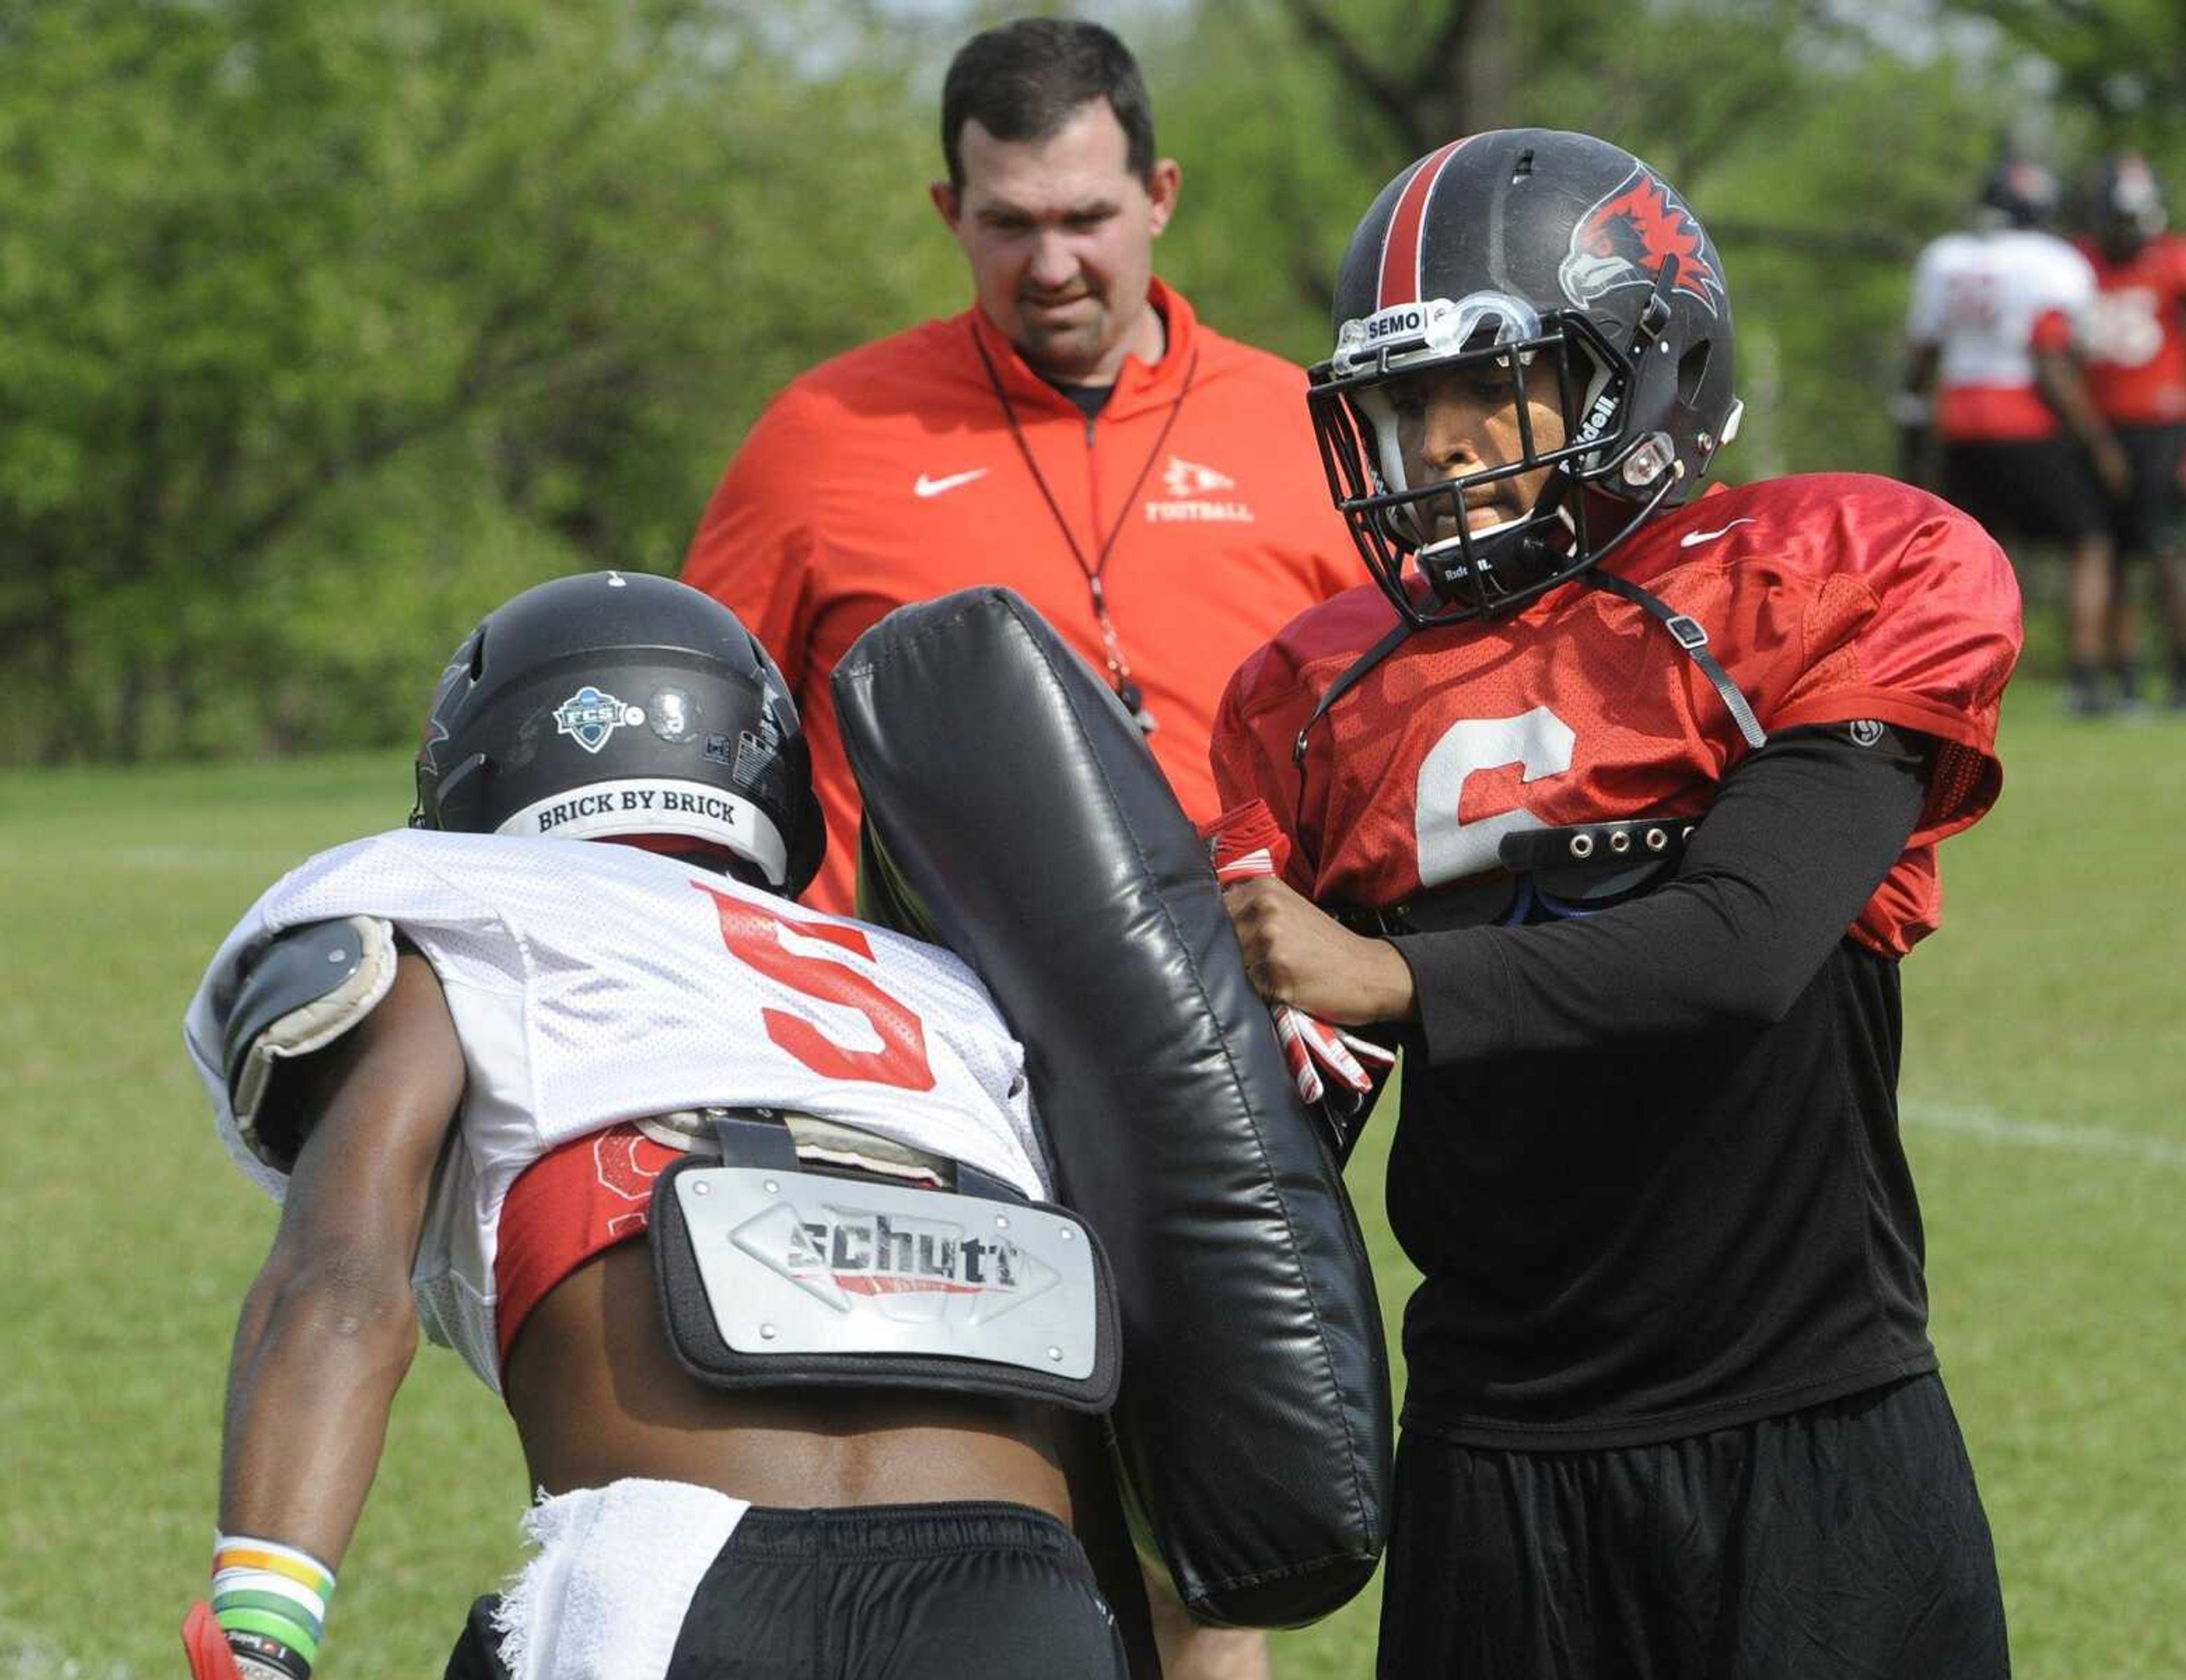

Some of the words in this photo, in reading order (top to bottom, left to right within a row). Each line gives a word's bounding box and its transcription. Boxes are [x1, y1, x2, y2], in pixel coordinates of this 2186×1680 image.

[1369, 312, 1420, 339] SEMO
[1145, 500, 1254, 524] FOOTBALL
[538, 791, 614, 833] BRICK
[621, 790, 656, 809] BY
[663, 791, 735, 825] BRICK
[689, 880, 936, 1092] 5
